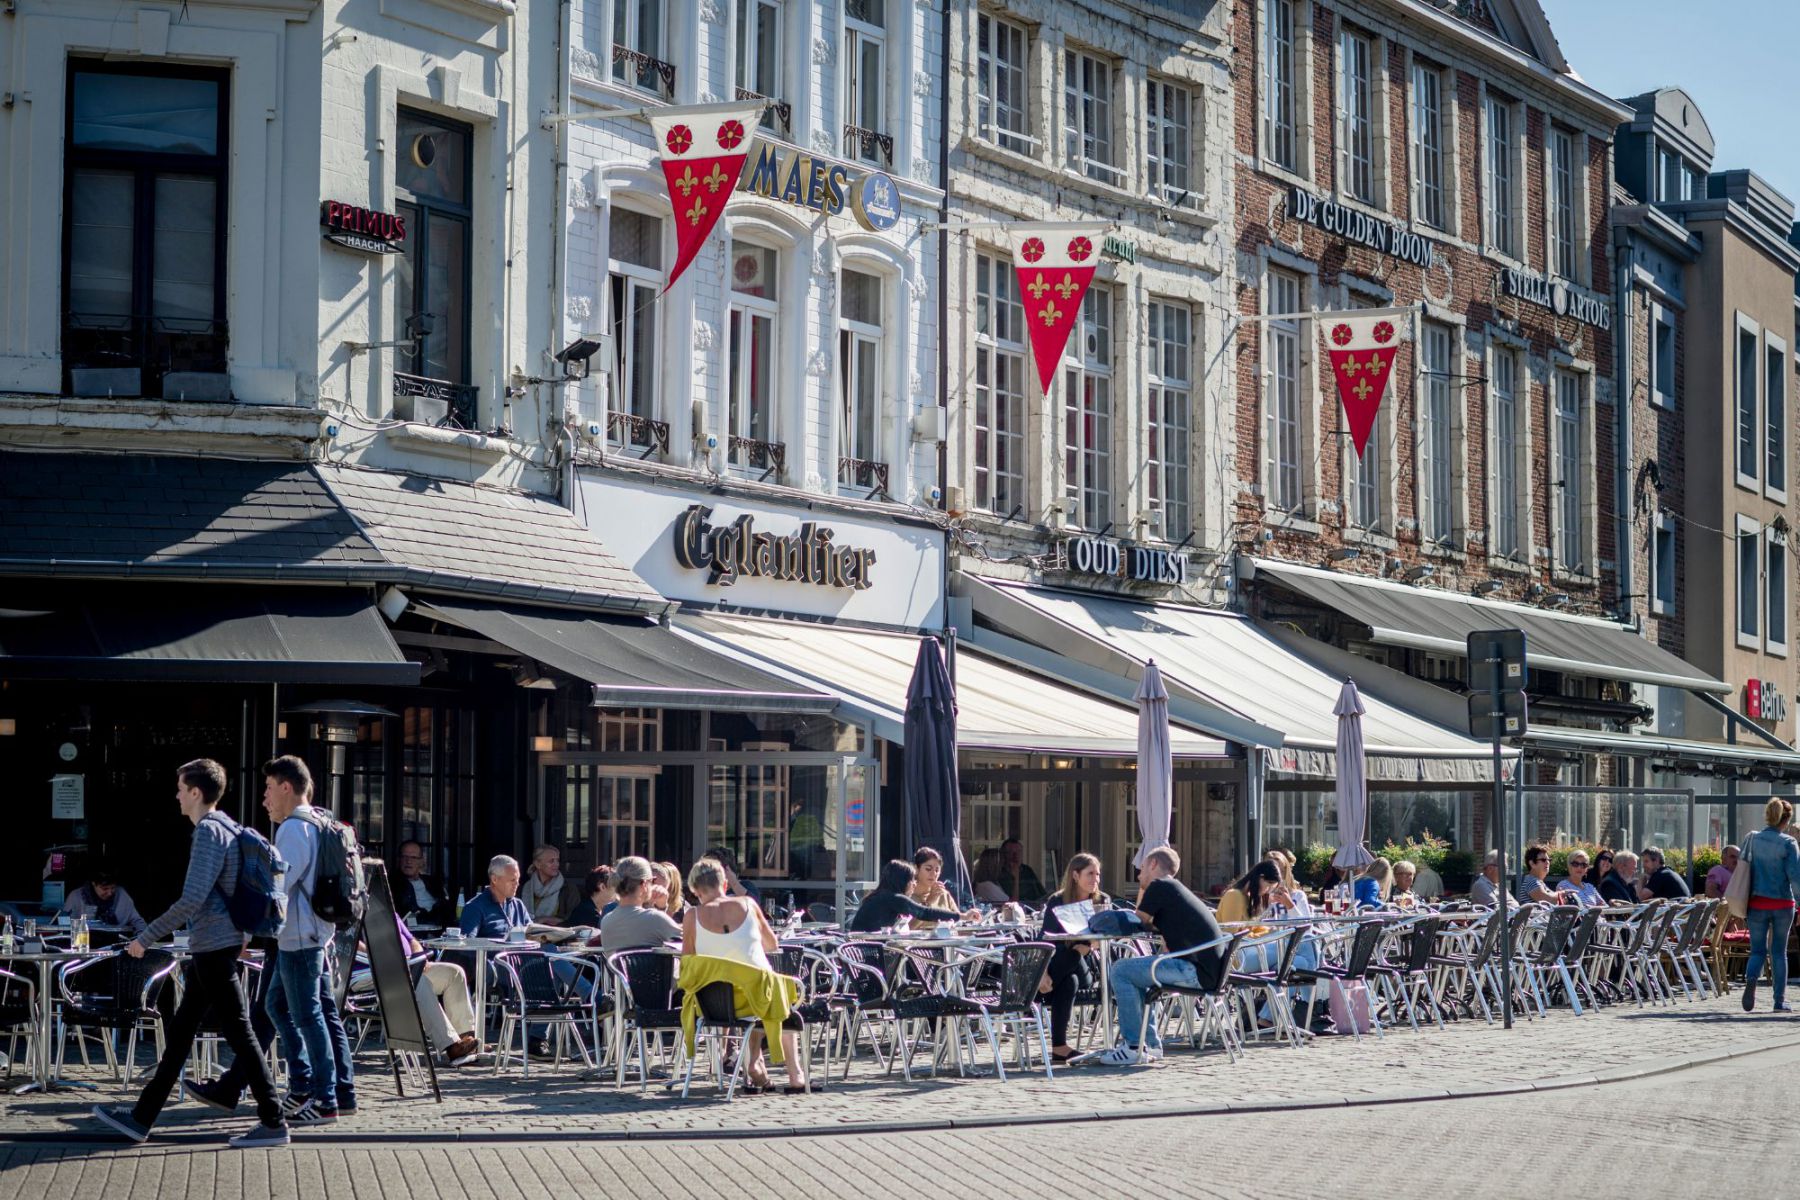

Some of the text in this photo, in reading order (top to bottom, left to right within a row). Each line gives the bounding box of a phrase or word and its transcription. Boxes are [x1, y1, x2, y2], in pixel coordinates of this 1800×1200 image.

[746, 143, 847, 215] MAES
[327, 200, 407, 242] PRIMUS
[346, 236, 387, 252] HAACHT
[1295, 188, 1434, 269] DE GULDEN BOOM
[1508, 268, 1611, 331] STELLA ARTOIS
[674, 504, 877, 590] Eglantier
[1076, 537, 1189, 585] OUD DIEST
[1760, 680, 1787, 722] Belfius
